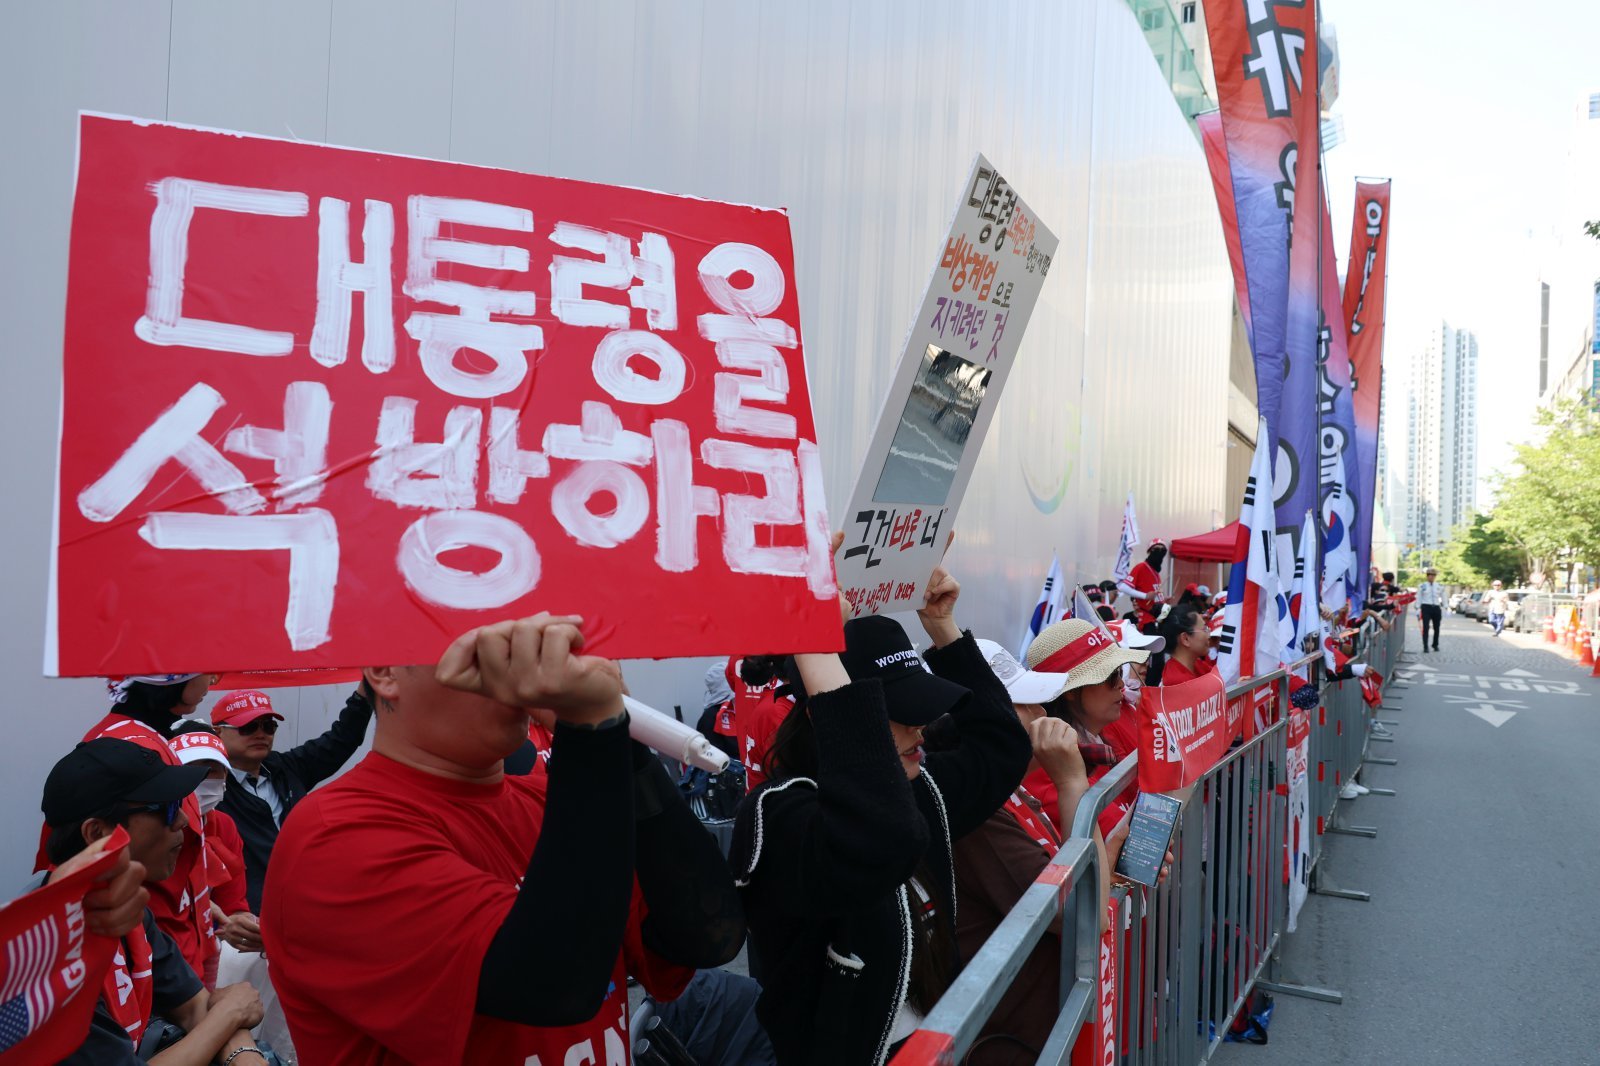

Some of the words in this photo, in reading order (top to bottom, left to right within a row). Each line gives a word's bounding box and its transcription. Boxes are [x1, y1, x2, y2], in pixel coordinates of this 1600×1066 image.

[967, 166, 1018, 252] 대통령
[134, 175, 799, 439] 대통령을
[930, 296, 988, 350] 지키려던
[985, 310, 1010, 364] 것
